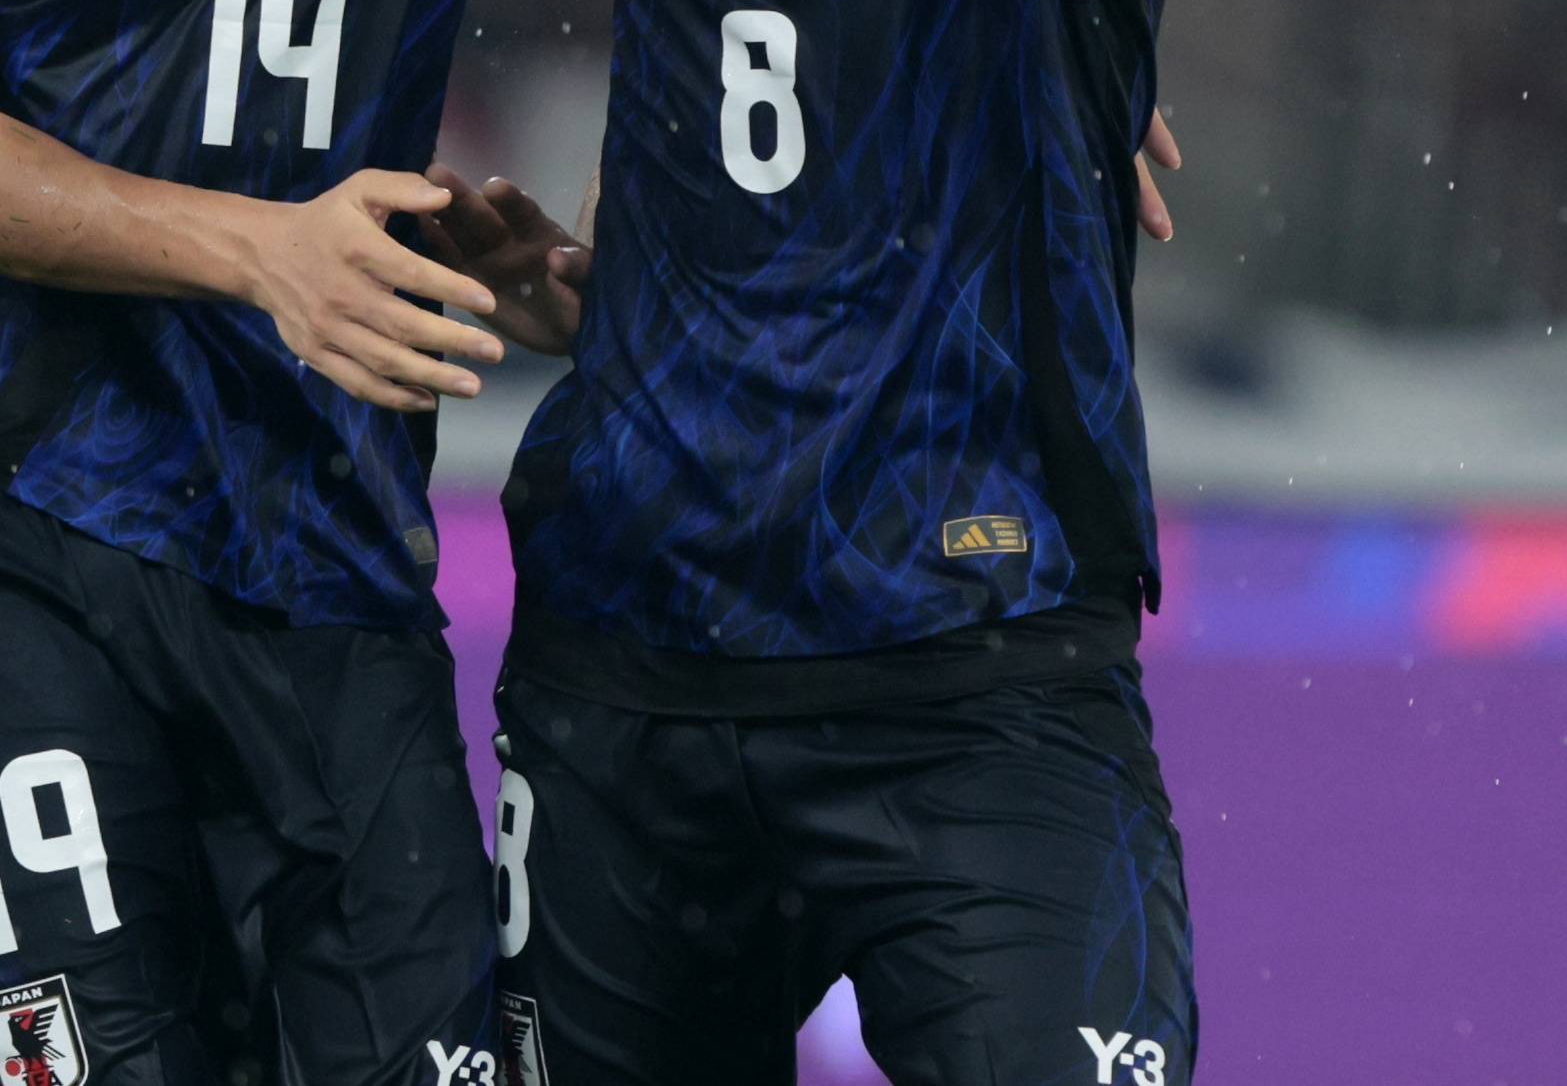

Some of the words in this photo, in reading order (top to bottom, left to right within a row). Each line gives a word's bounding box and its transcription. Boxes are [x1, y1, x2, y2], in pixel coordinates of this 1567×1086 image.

[720, 9, 806, 194] 8
[495, 768, 534, 958] 8
[426, 1039, 496, 1086] Y-3
[1077, 1026, 1166, 1086] Y-3
